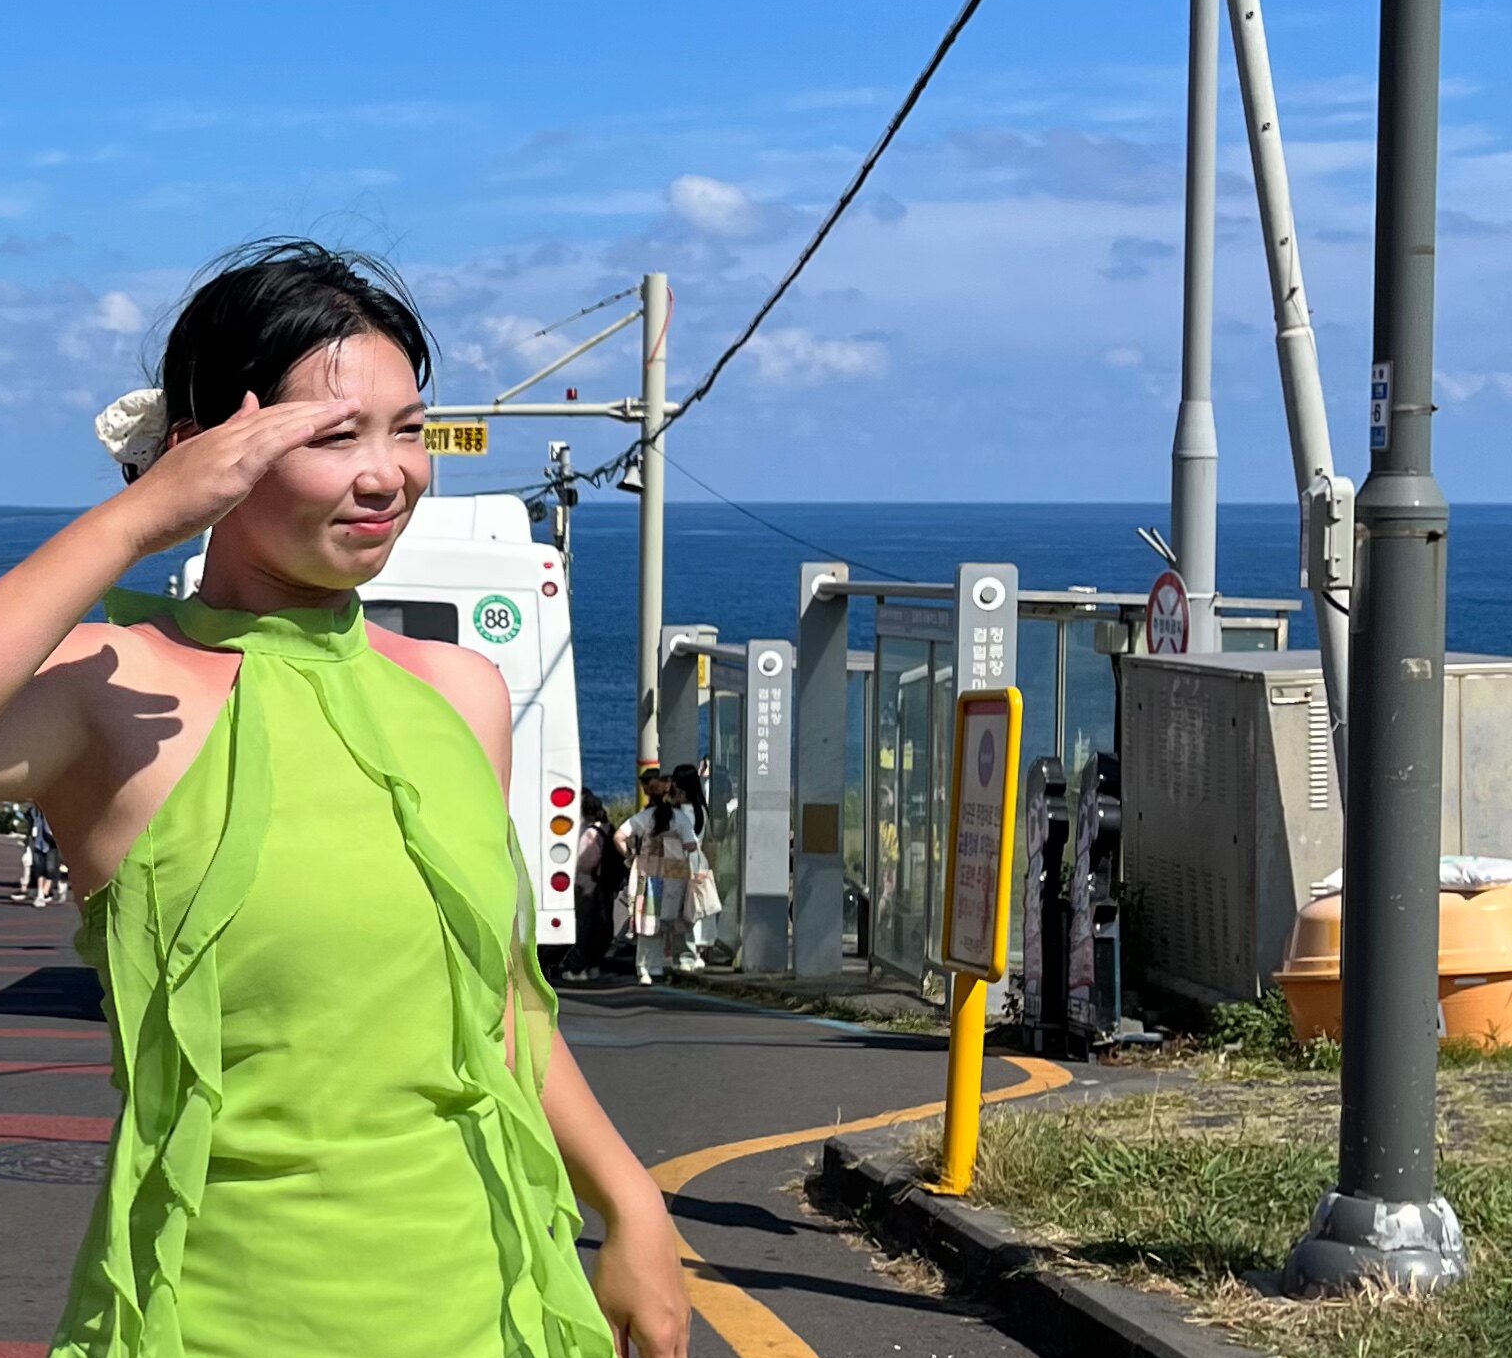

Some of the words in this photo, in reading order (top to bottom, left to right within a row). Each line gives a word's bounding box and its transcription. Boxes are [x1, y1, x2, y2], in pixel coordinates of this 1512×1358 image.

[424, 428, 450, 450] CCTV
[453, 427, 483, 452] 작동중
[484, 608, 510, 629] 88
[989, 627, 1004, 677] 정류장
[770, 688, 782, 726] 정류장
